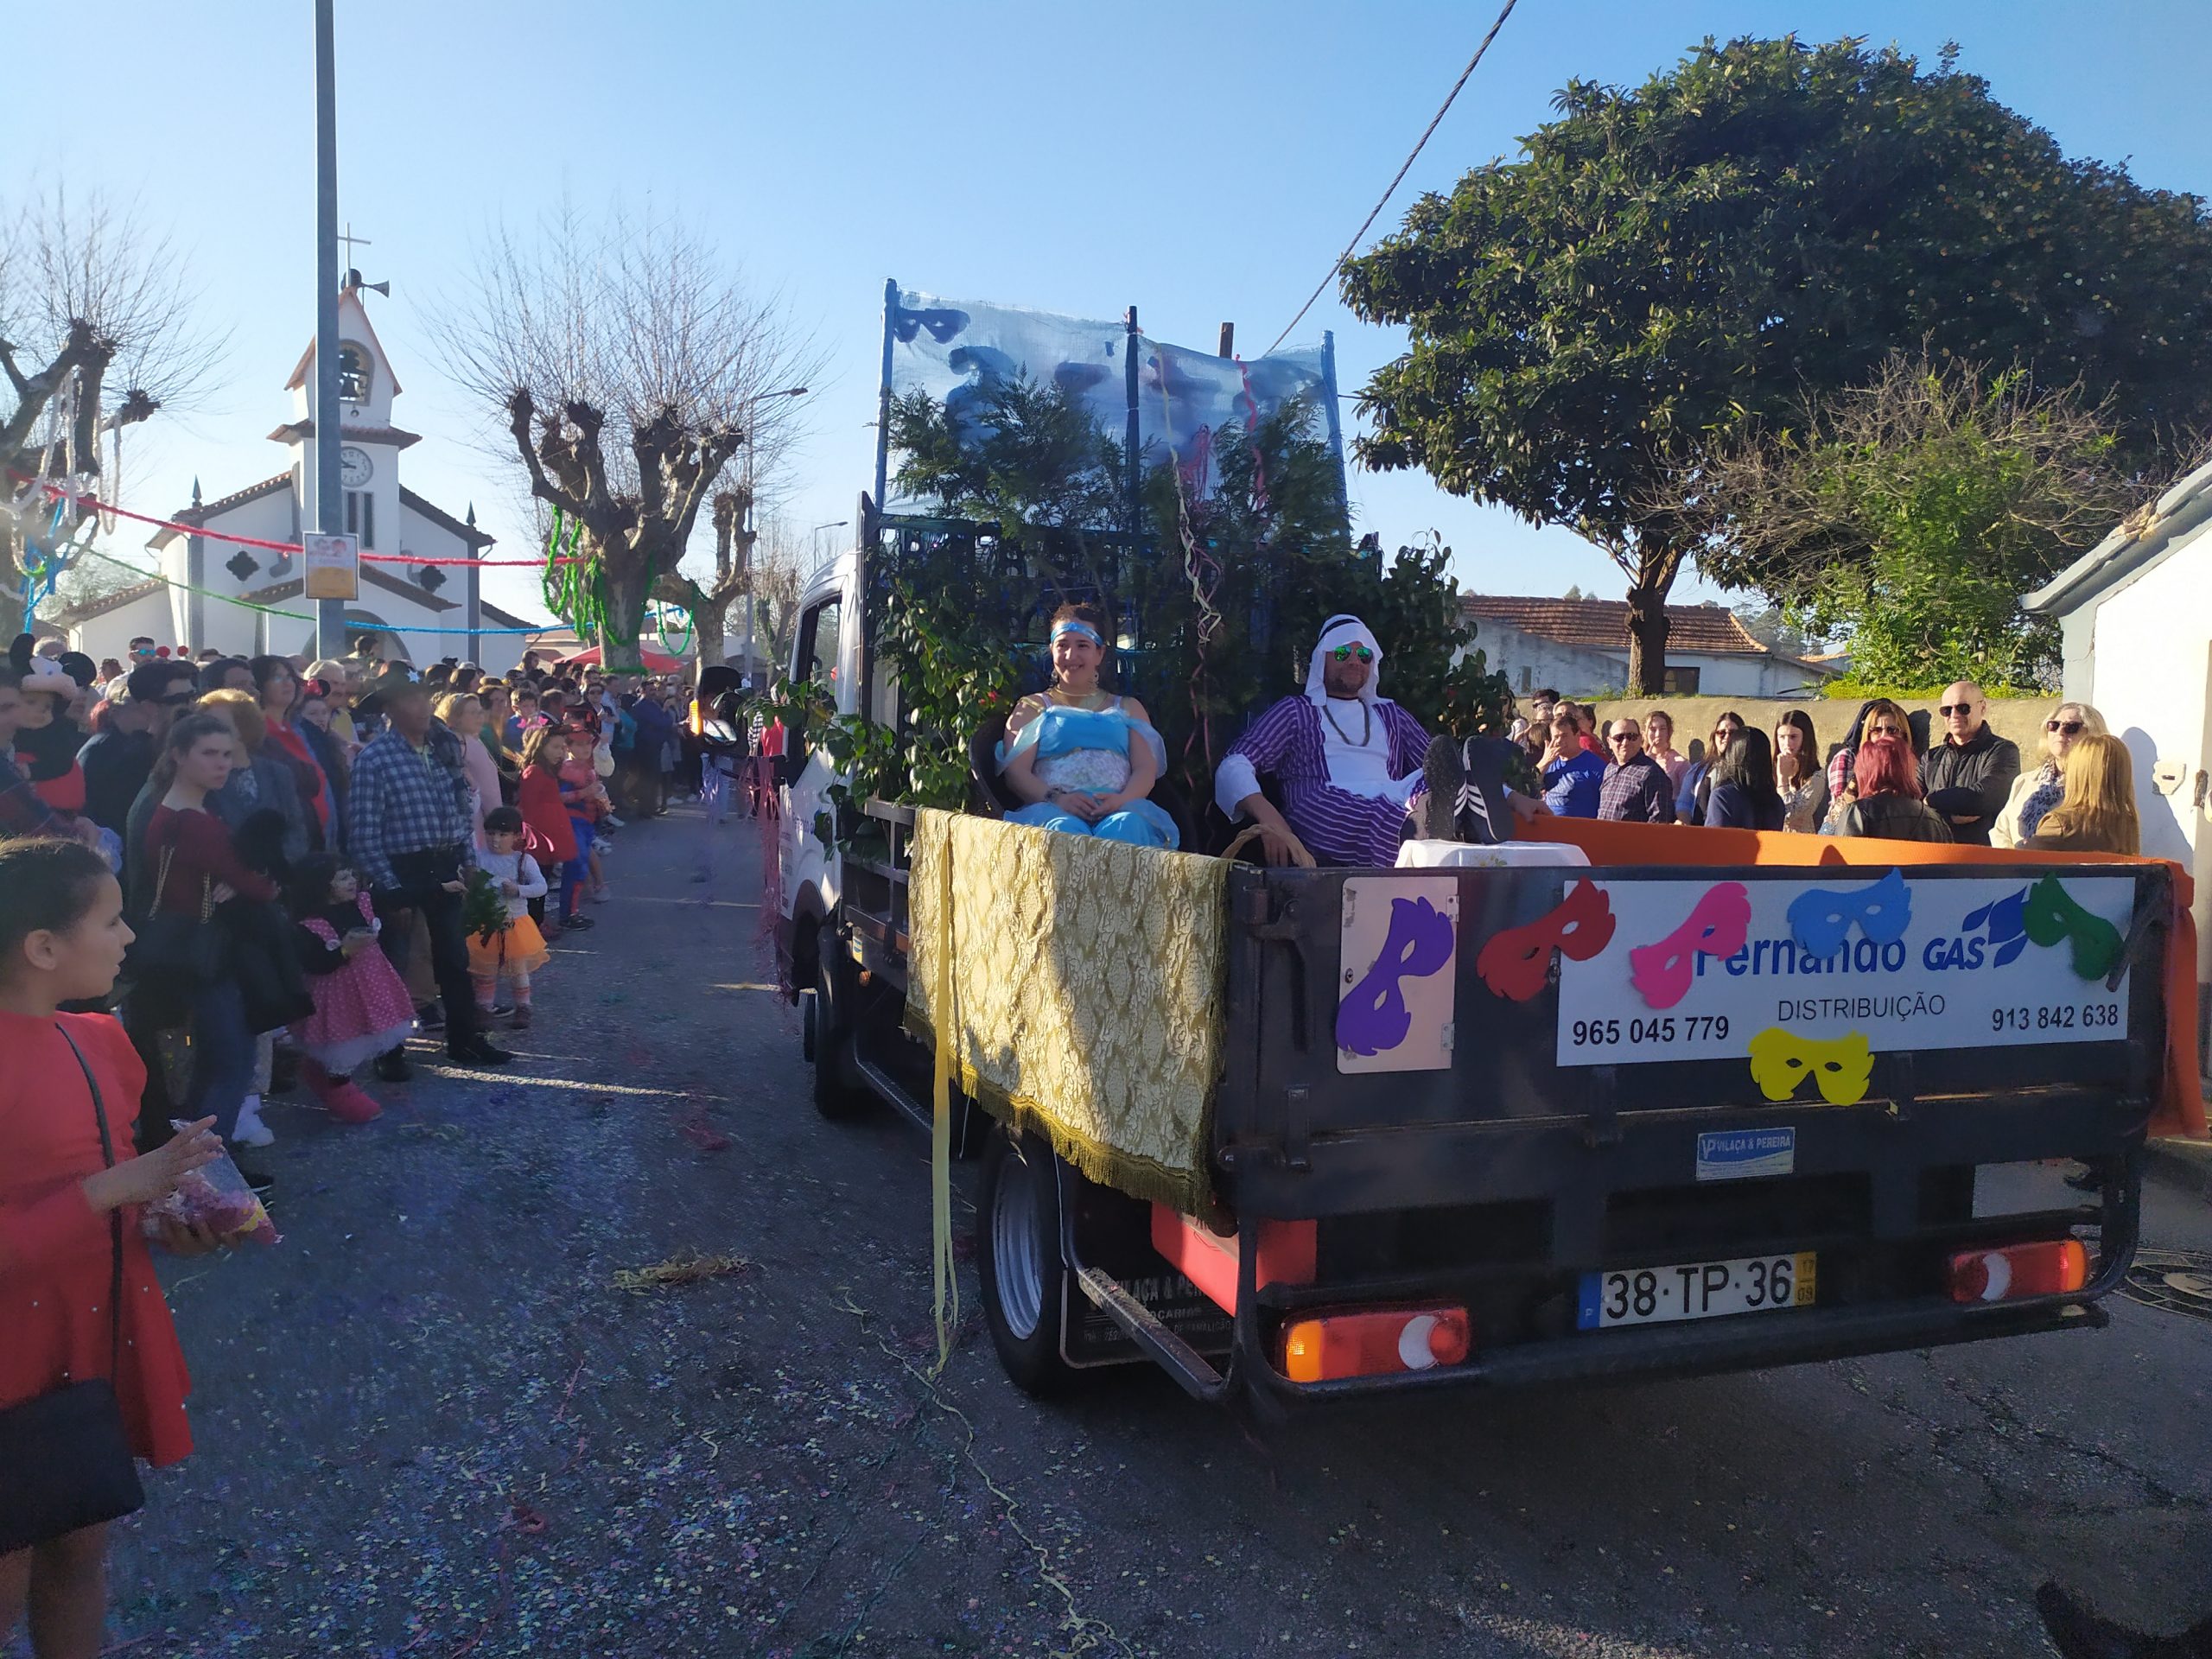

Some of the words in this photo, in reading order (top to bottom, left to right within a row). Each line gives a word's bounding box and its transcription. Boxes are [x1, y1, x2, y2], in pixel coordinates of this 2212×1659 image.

[1923, 937, 1986, 971] GAS
[1778, 992, 1945, 1022] DISTRIBUIÇÃO
[1992, 1007, 2030, 1032] 913
[2037, 1005, 2075, 1029] 842
[2082, 1004, 2119, 1027] 638
[1573, 1020, 1620, 1046] 965
[1630, 1017, 1675, 1044] 045
[1685, 1015, 1730, 1041] 779
[1717, 1139, 1746, 1154] VILAÇA
[1747, 1137, 1755, 1150] &
[1757, 1135, 1791, 1149] PEREIRA
